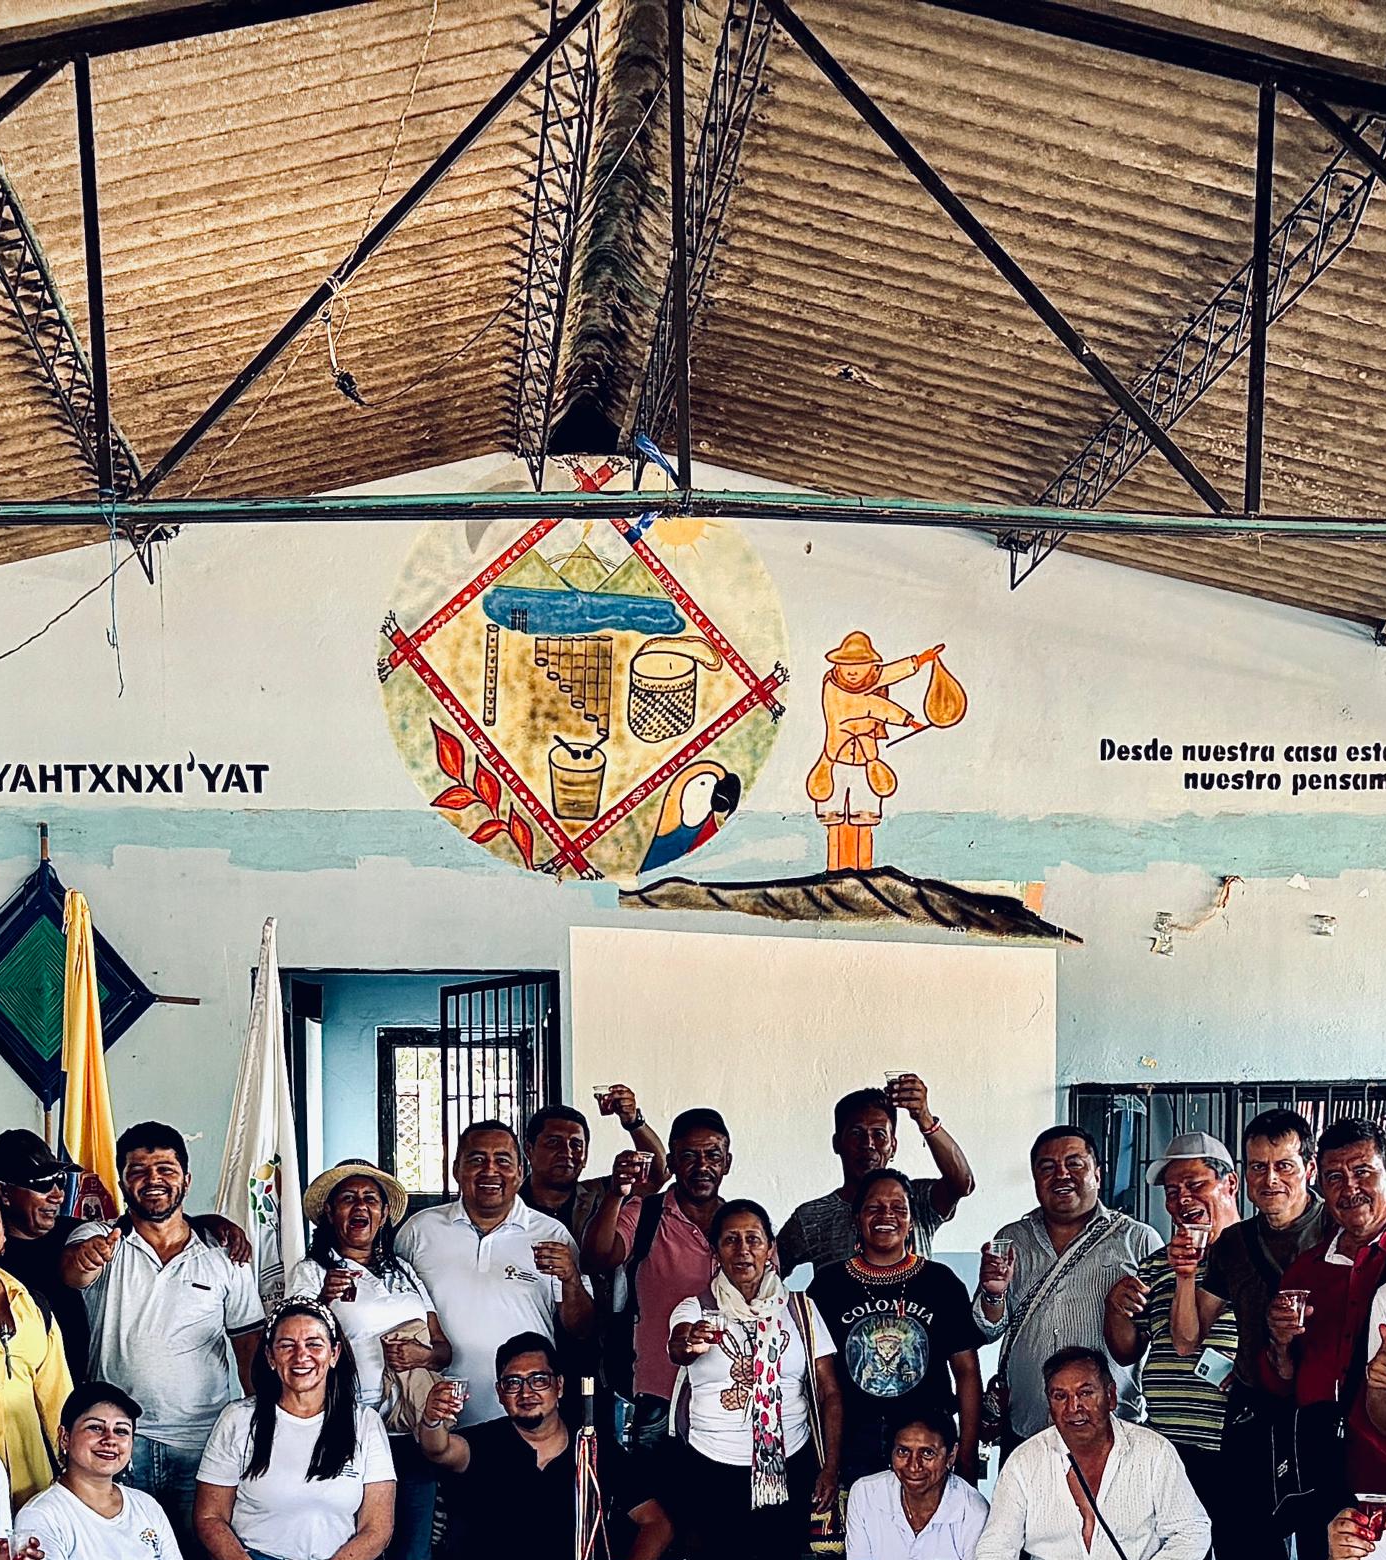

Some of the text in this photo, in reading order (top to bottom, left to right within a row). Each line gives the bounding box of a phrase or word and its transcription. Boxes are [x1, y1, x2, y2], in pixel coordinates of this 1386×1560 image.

[1100, 738, 1173, 762] Desde
[1182, 742, 1275, 762] nuestra
[1284, 744, 1337, 762] casa
[1184, 770, 1281, 791] nuestro
[841, 1299, 934, 1325] COLOMBIA
